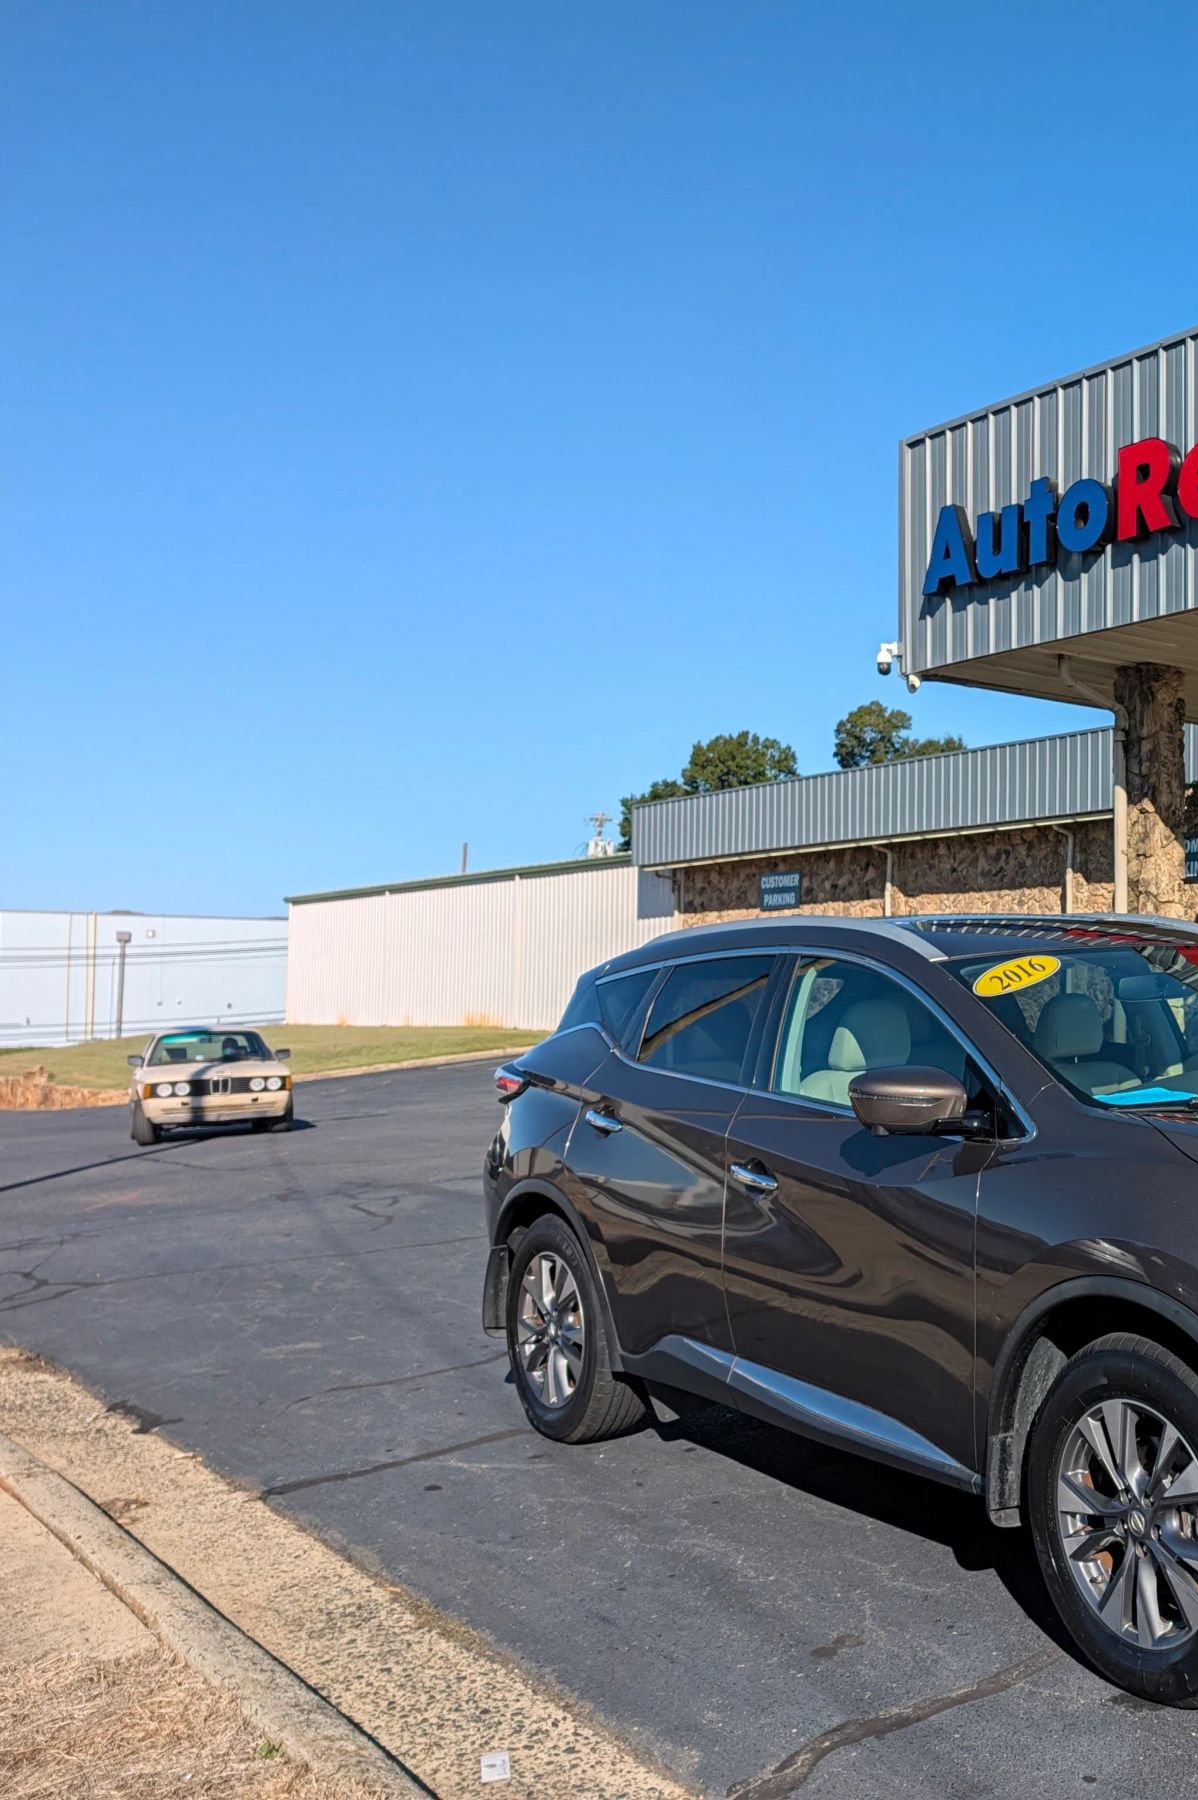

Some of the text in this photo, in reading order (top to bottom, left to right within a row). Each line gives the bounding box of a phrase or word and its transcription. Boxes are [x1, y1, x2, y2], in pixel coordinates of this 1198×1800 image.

[761, 874, 799, 889] CUSTOMER
[764, 893, 795, 907] PARKING
[989, 959, 1046, 990] 2016
